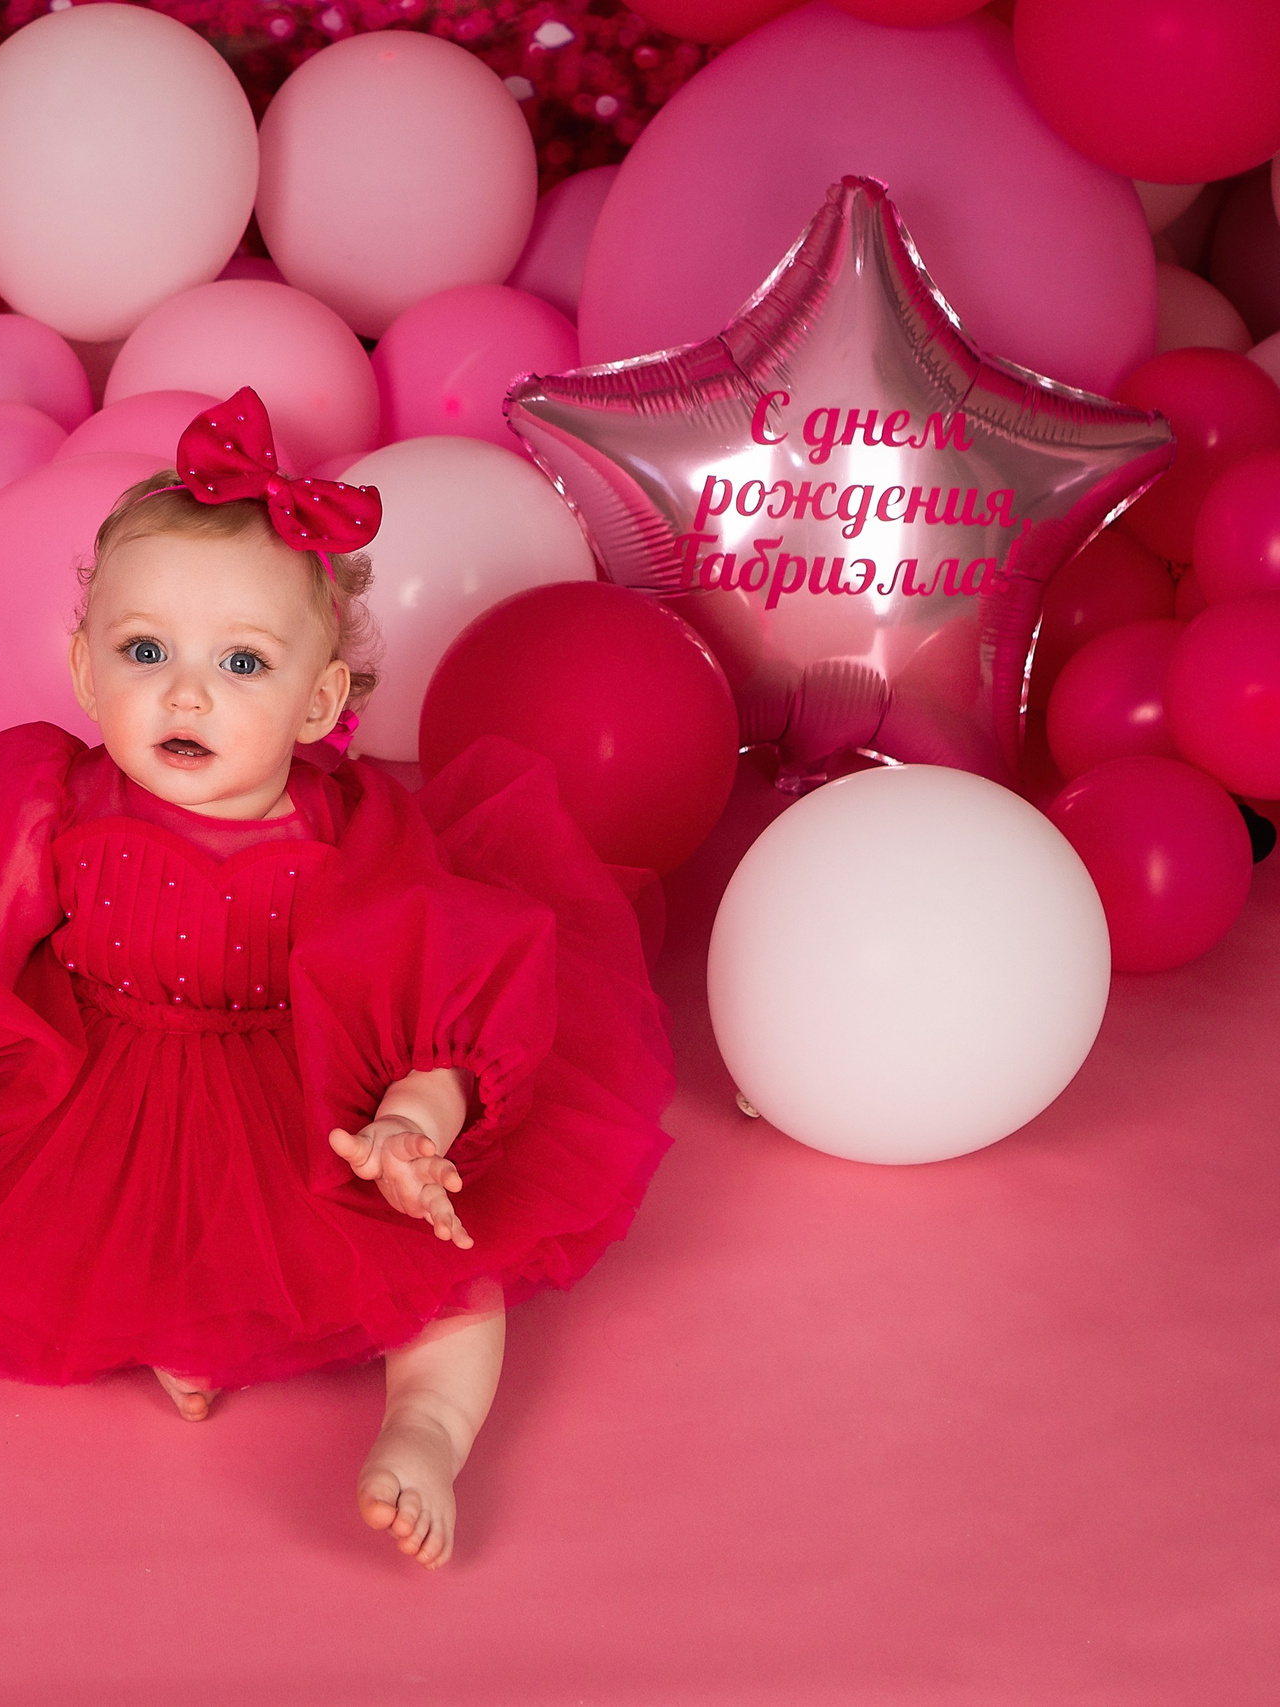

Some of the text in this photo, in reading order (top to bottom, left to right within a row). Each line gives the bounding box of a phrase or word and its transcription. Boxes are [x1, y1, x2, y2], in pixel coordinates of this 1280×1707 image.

[751, 391, 974, 465] С днем
[693, 474, 1033, 540] рождения,
[673, 533, 1022, 611] Габриэлла!
